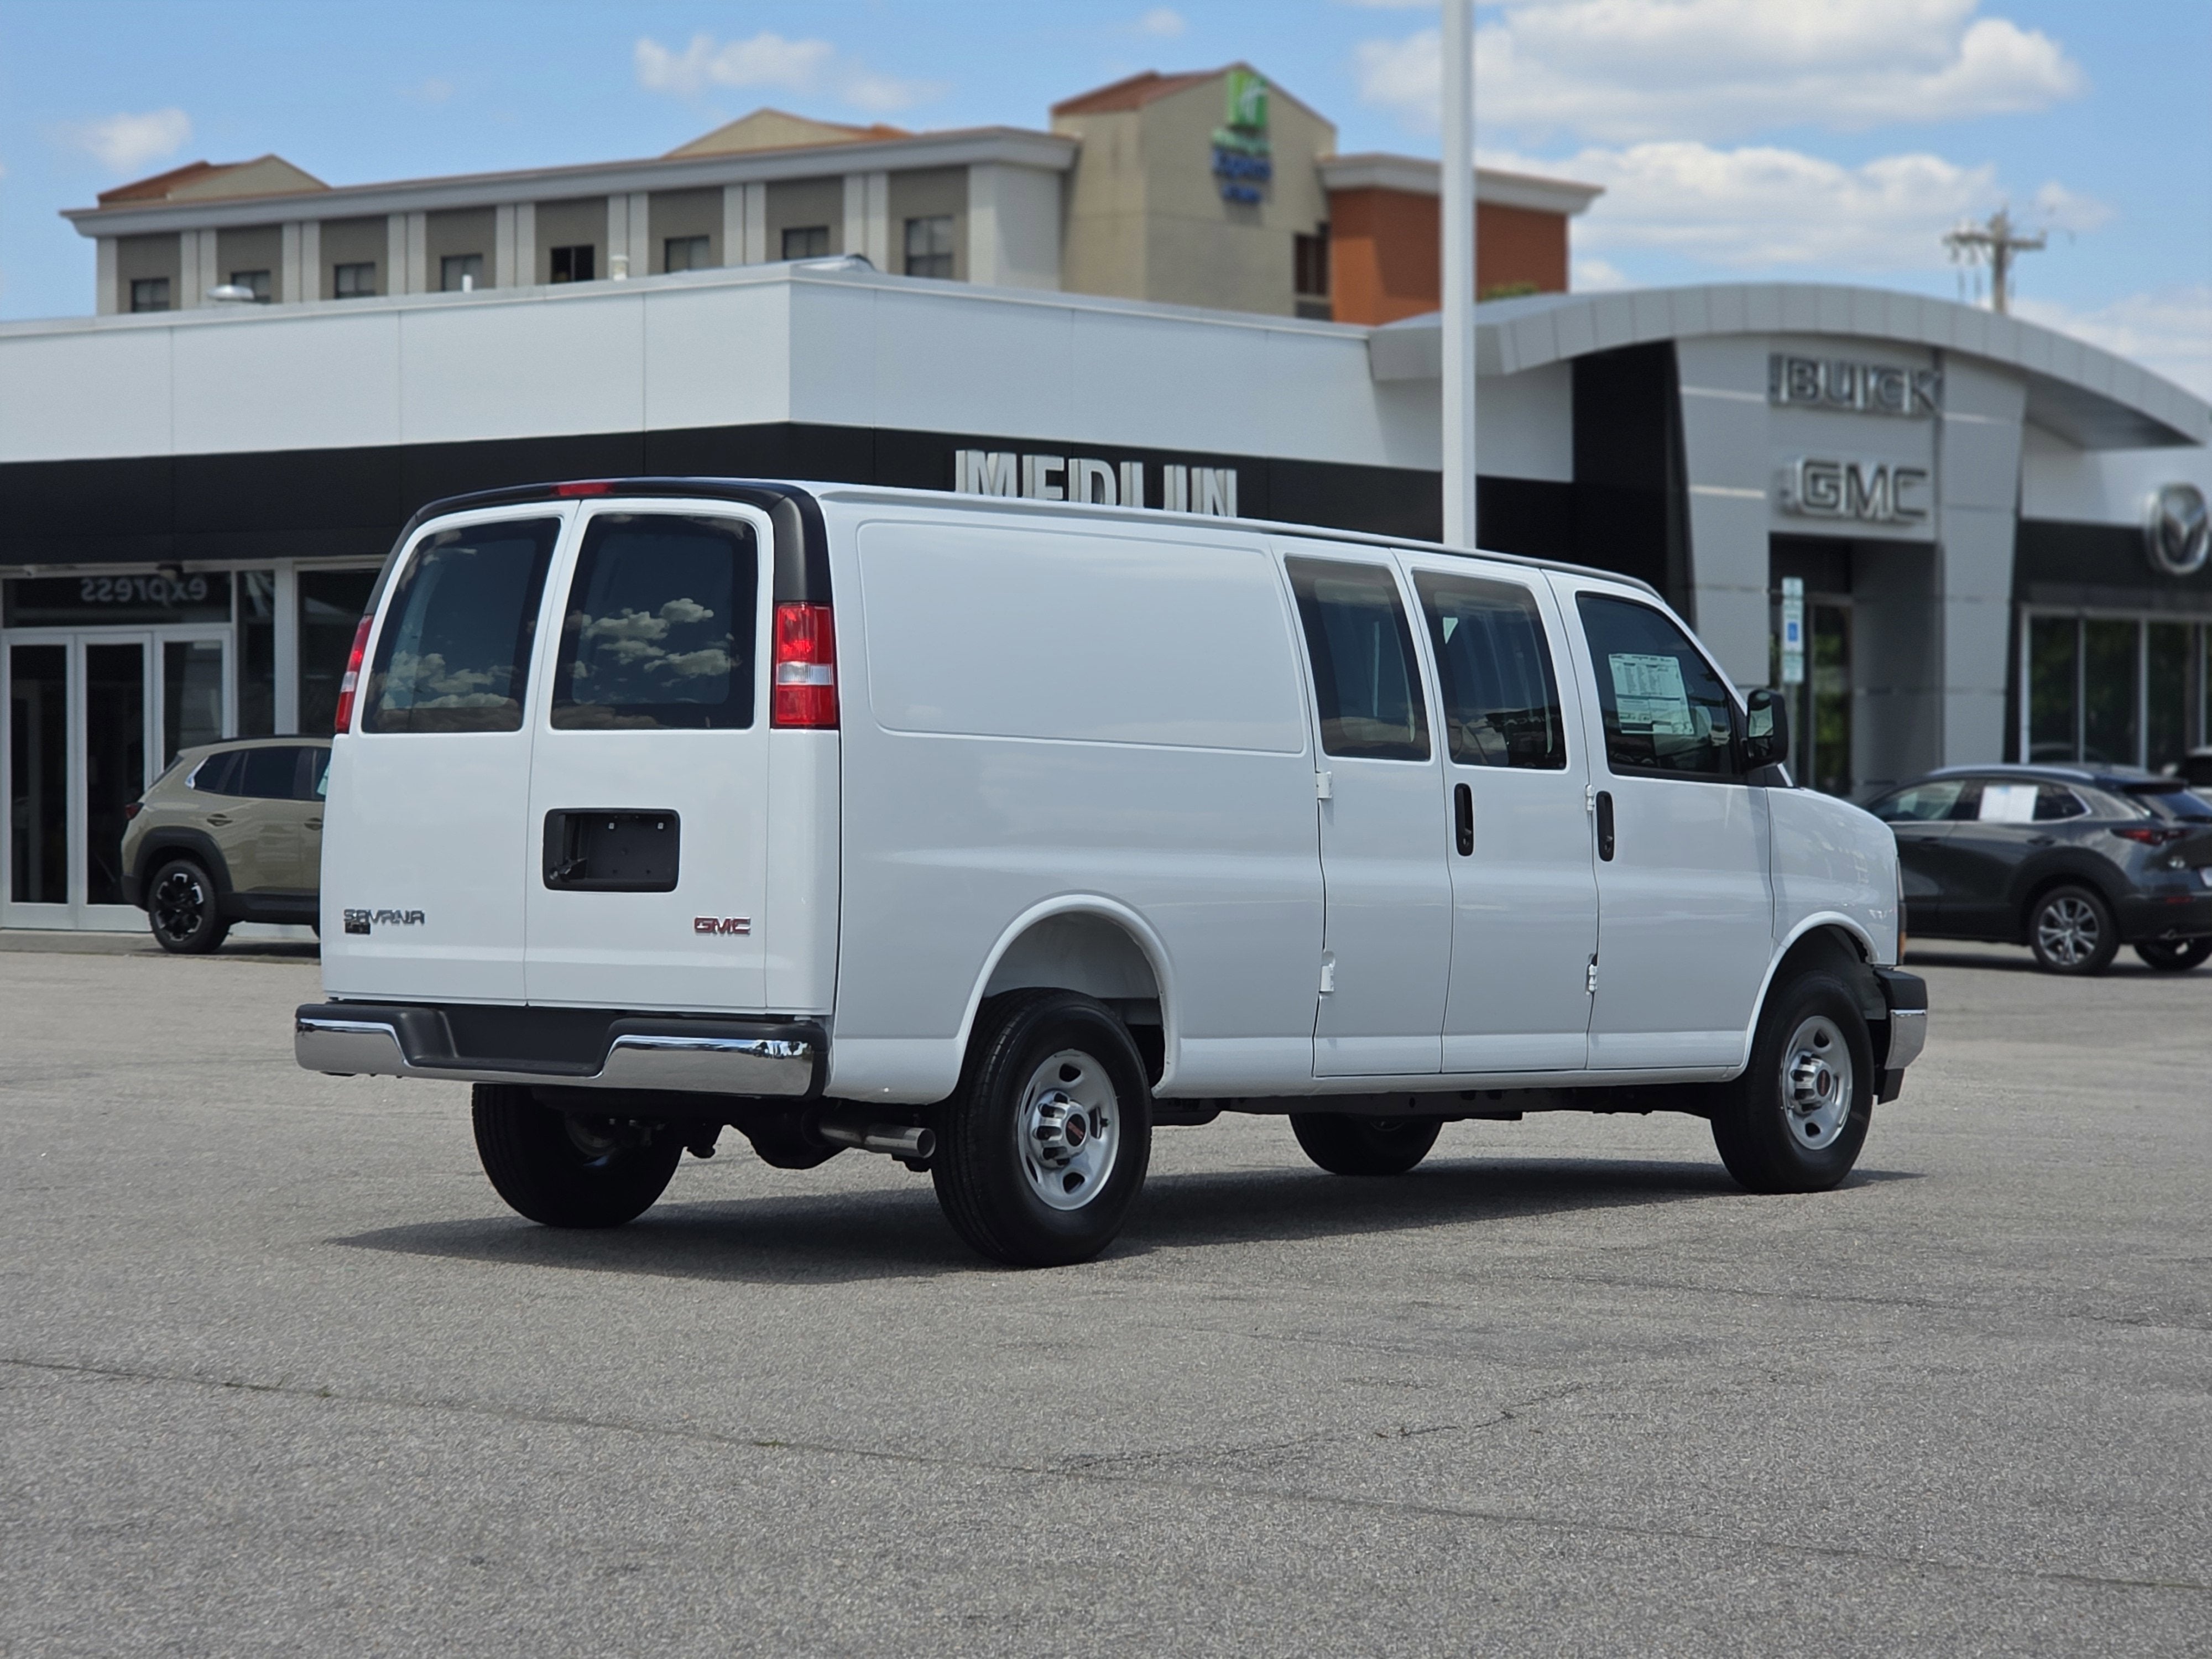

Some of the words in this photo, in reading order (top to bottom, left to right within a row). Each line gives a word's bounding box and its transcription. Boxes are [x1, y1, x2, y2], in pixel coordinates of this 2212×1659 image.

[1771, 354, 1942, 417] BUICK
[1785, 456, 1930, 522] GMC
[343, 909, 425, 926] SAVANA
[694, 916, 751, 936] GMC
